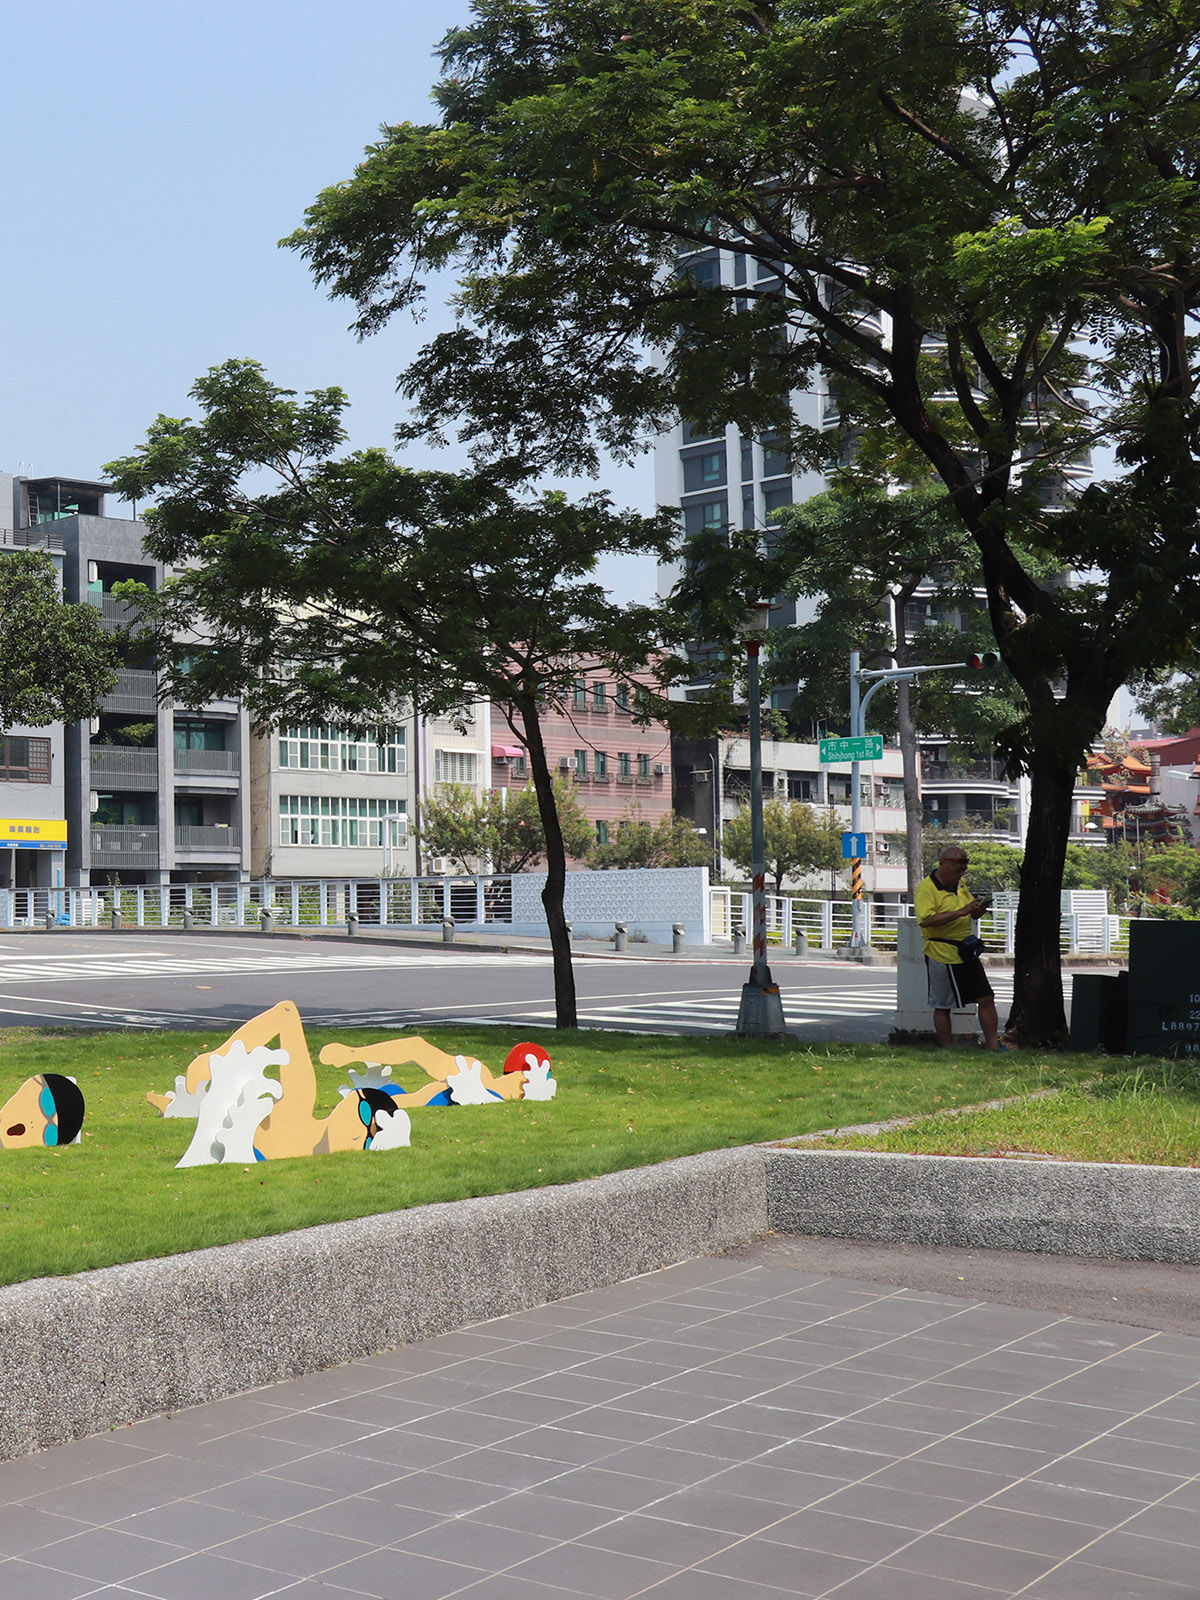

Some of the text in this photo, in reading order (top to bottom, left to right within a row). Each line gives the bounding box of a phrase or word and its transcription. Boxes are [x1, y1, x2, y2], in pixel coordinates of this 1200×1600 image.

[827, 738, 874, 751] 市中一路
[856, 750, 865, 758] 1st
